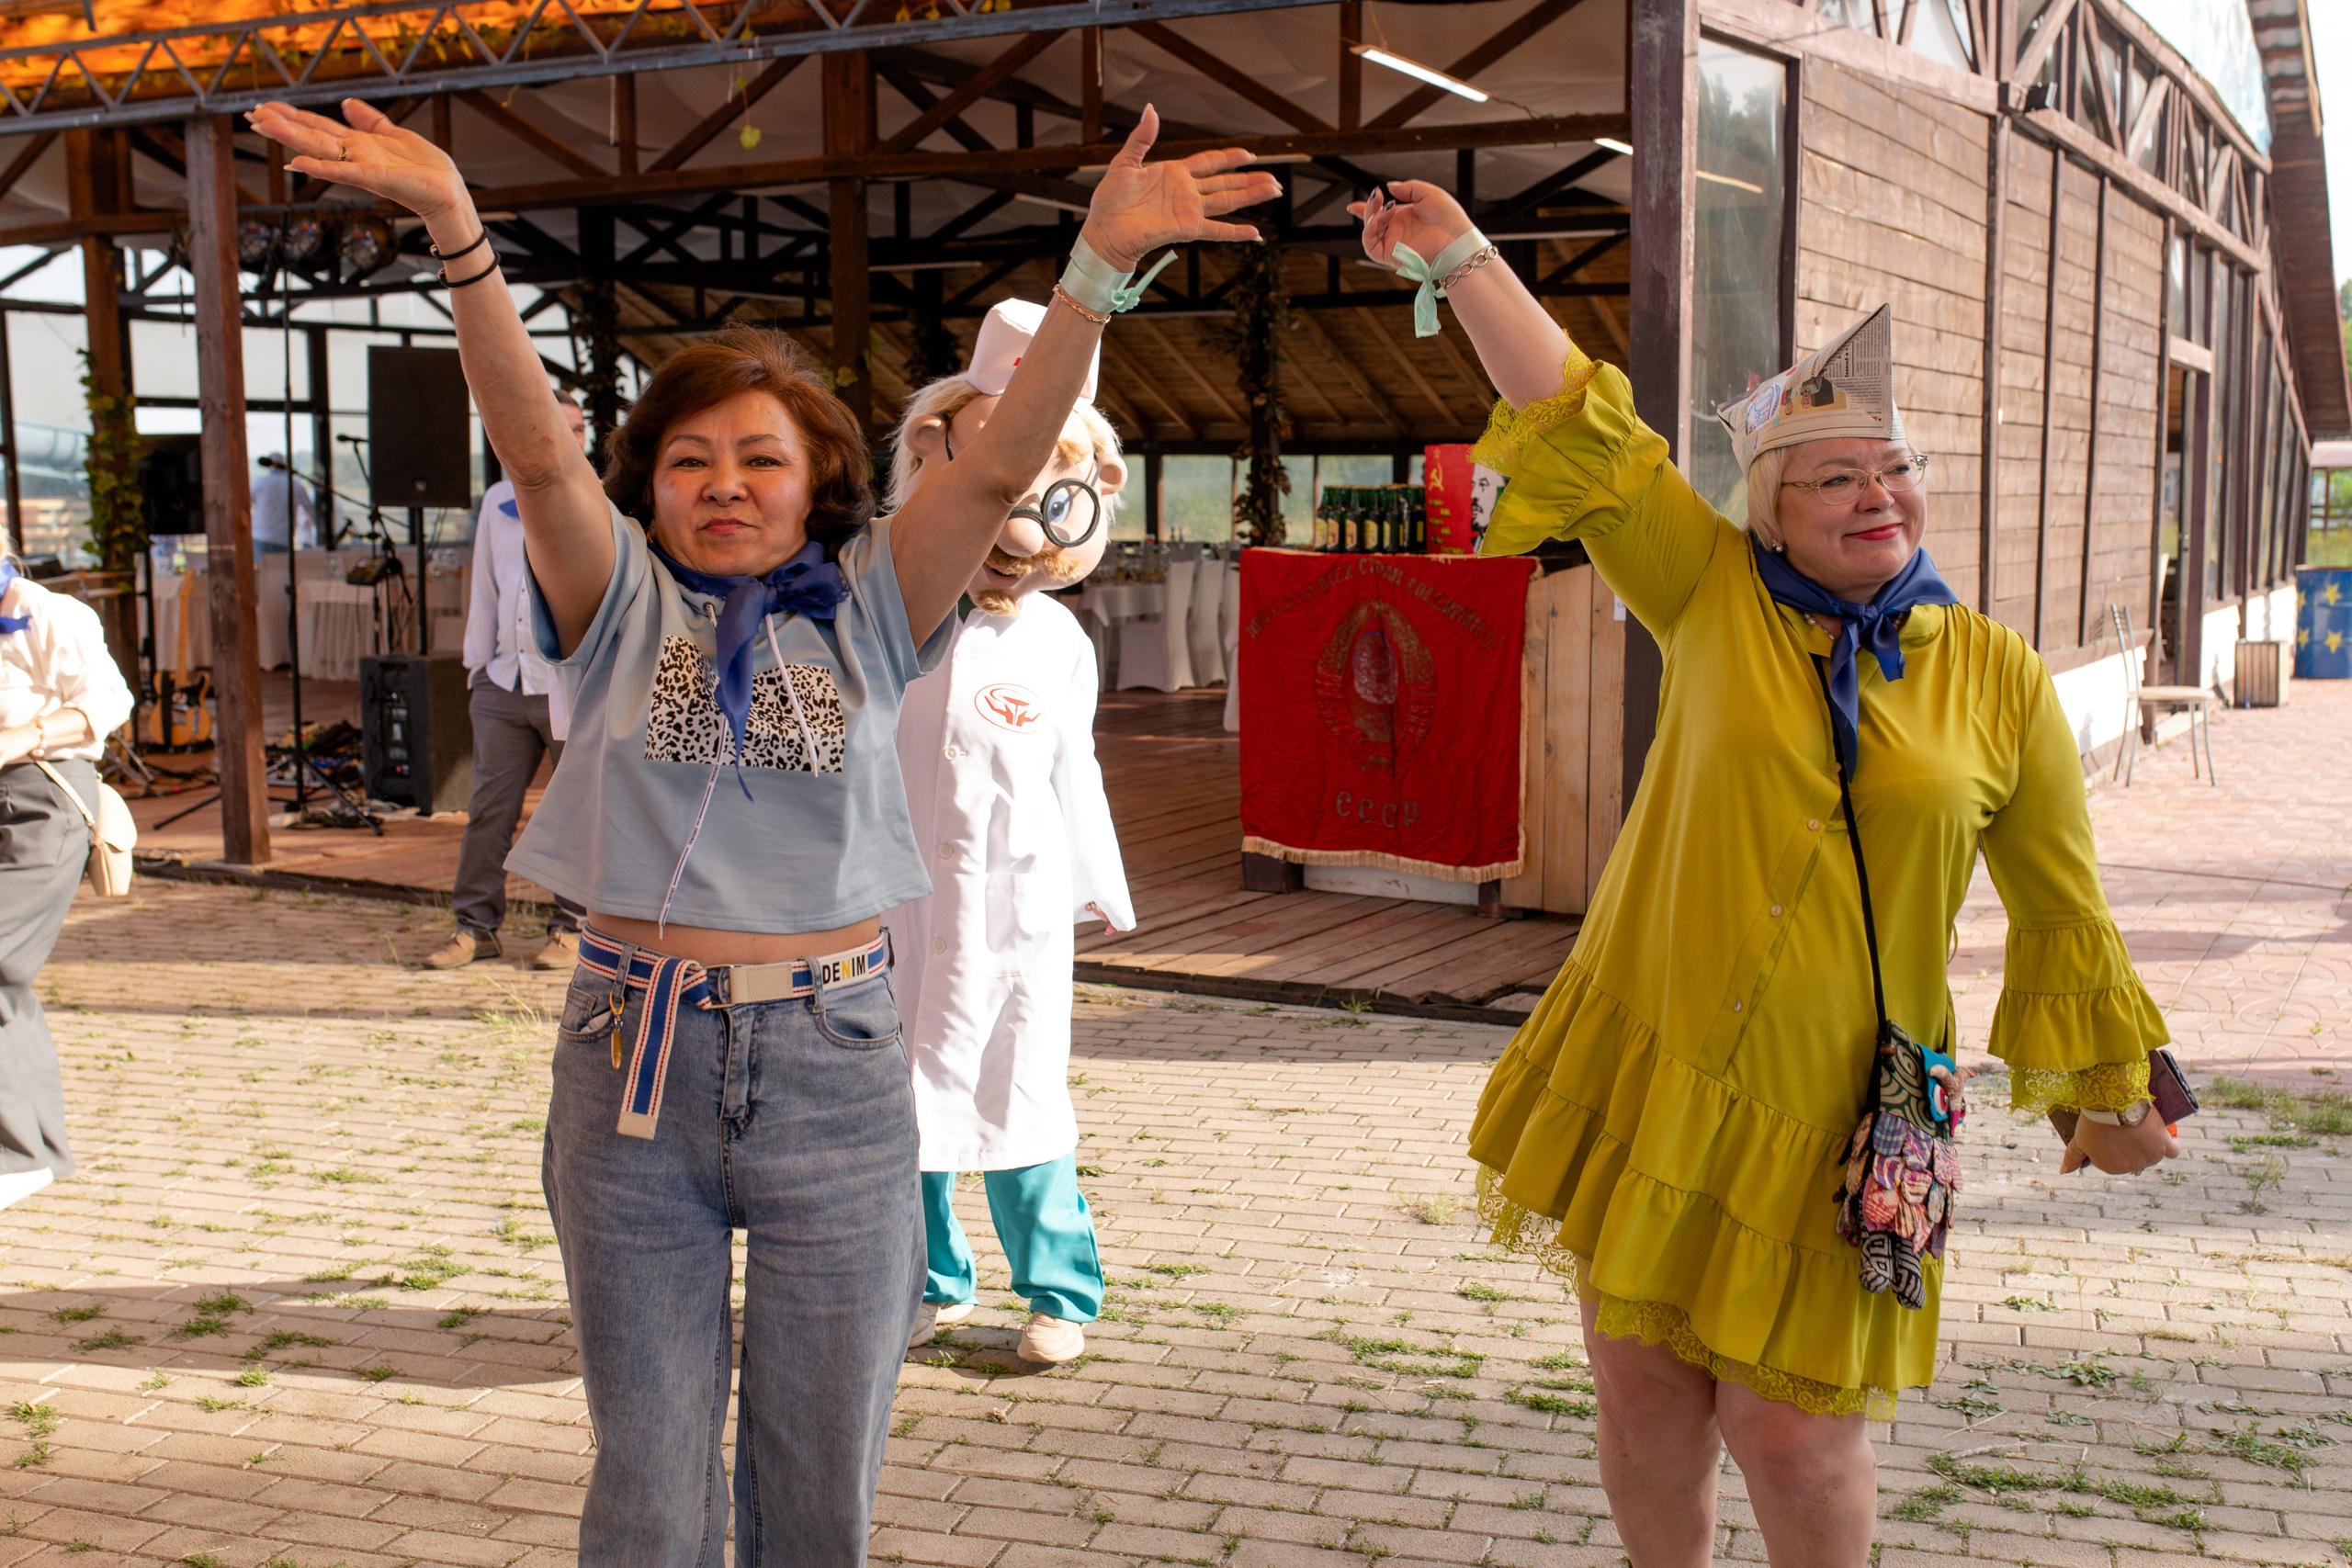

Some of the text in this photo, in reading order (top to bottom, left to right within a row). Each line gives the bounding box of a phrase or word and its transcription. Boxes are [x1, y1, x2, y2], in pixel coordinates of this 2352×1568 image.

[1358, 557, 1403, 586] СТРАН
[1336, 791, 1419, 829] СССР
[821, 953, 866, 985] DENIM
